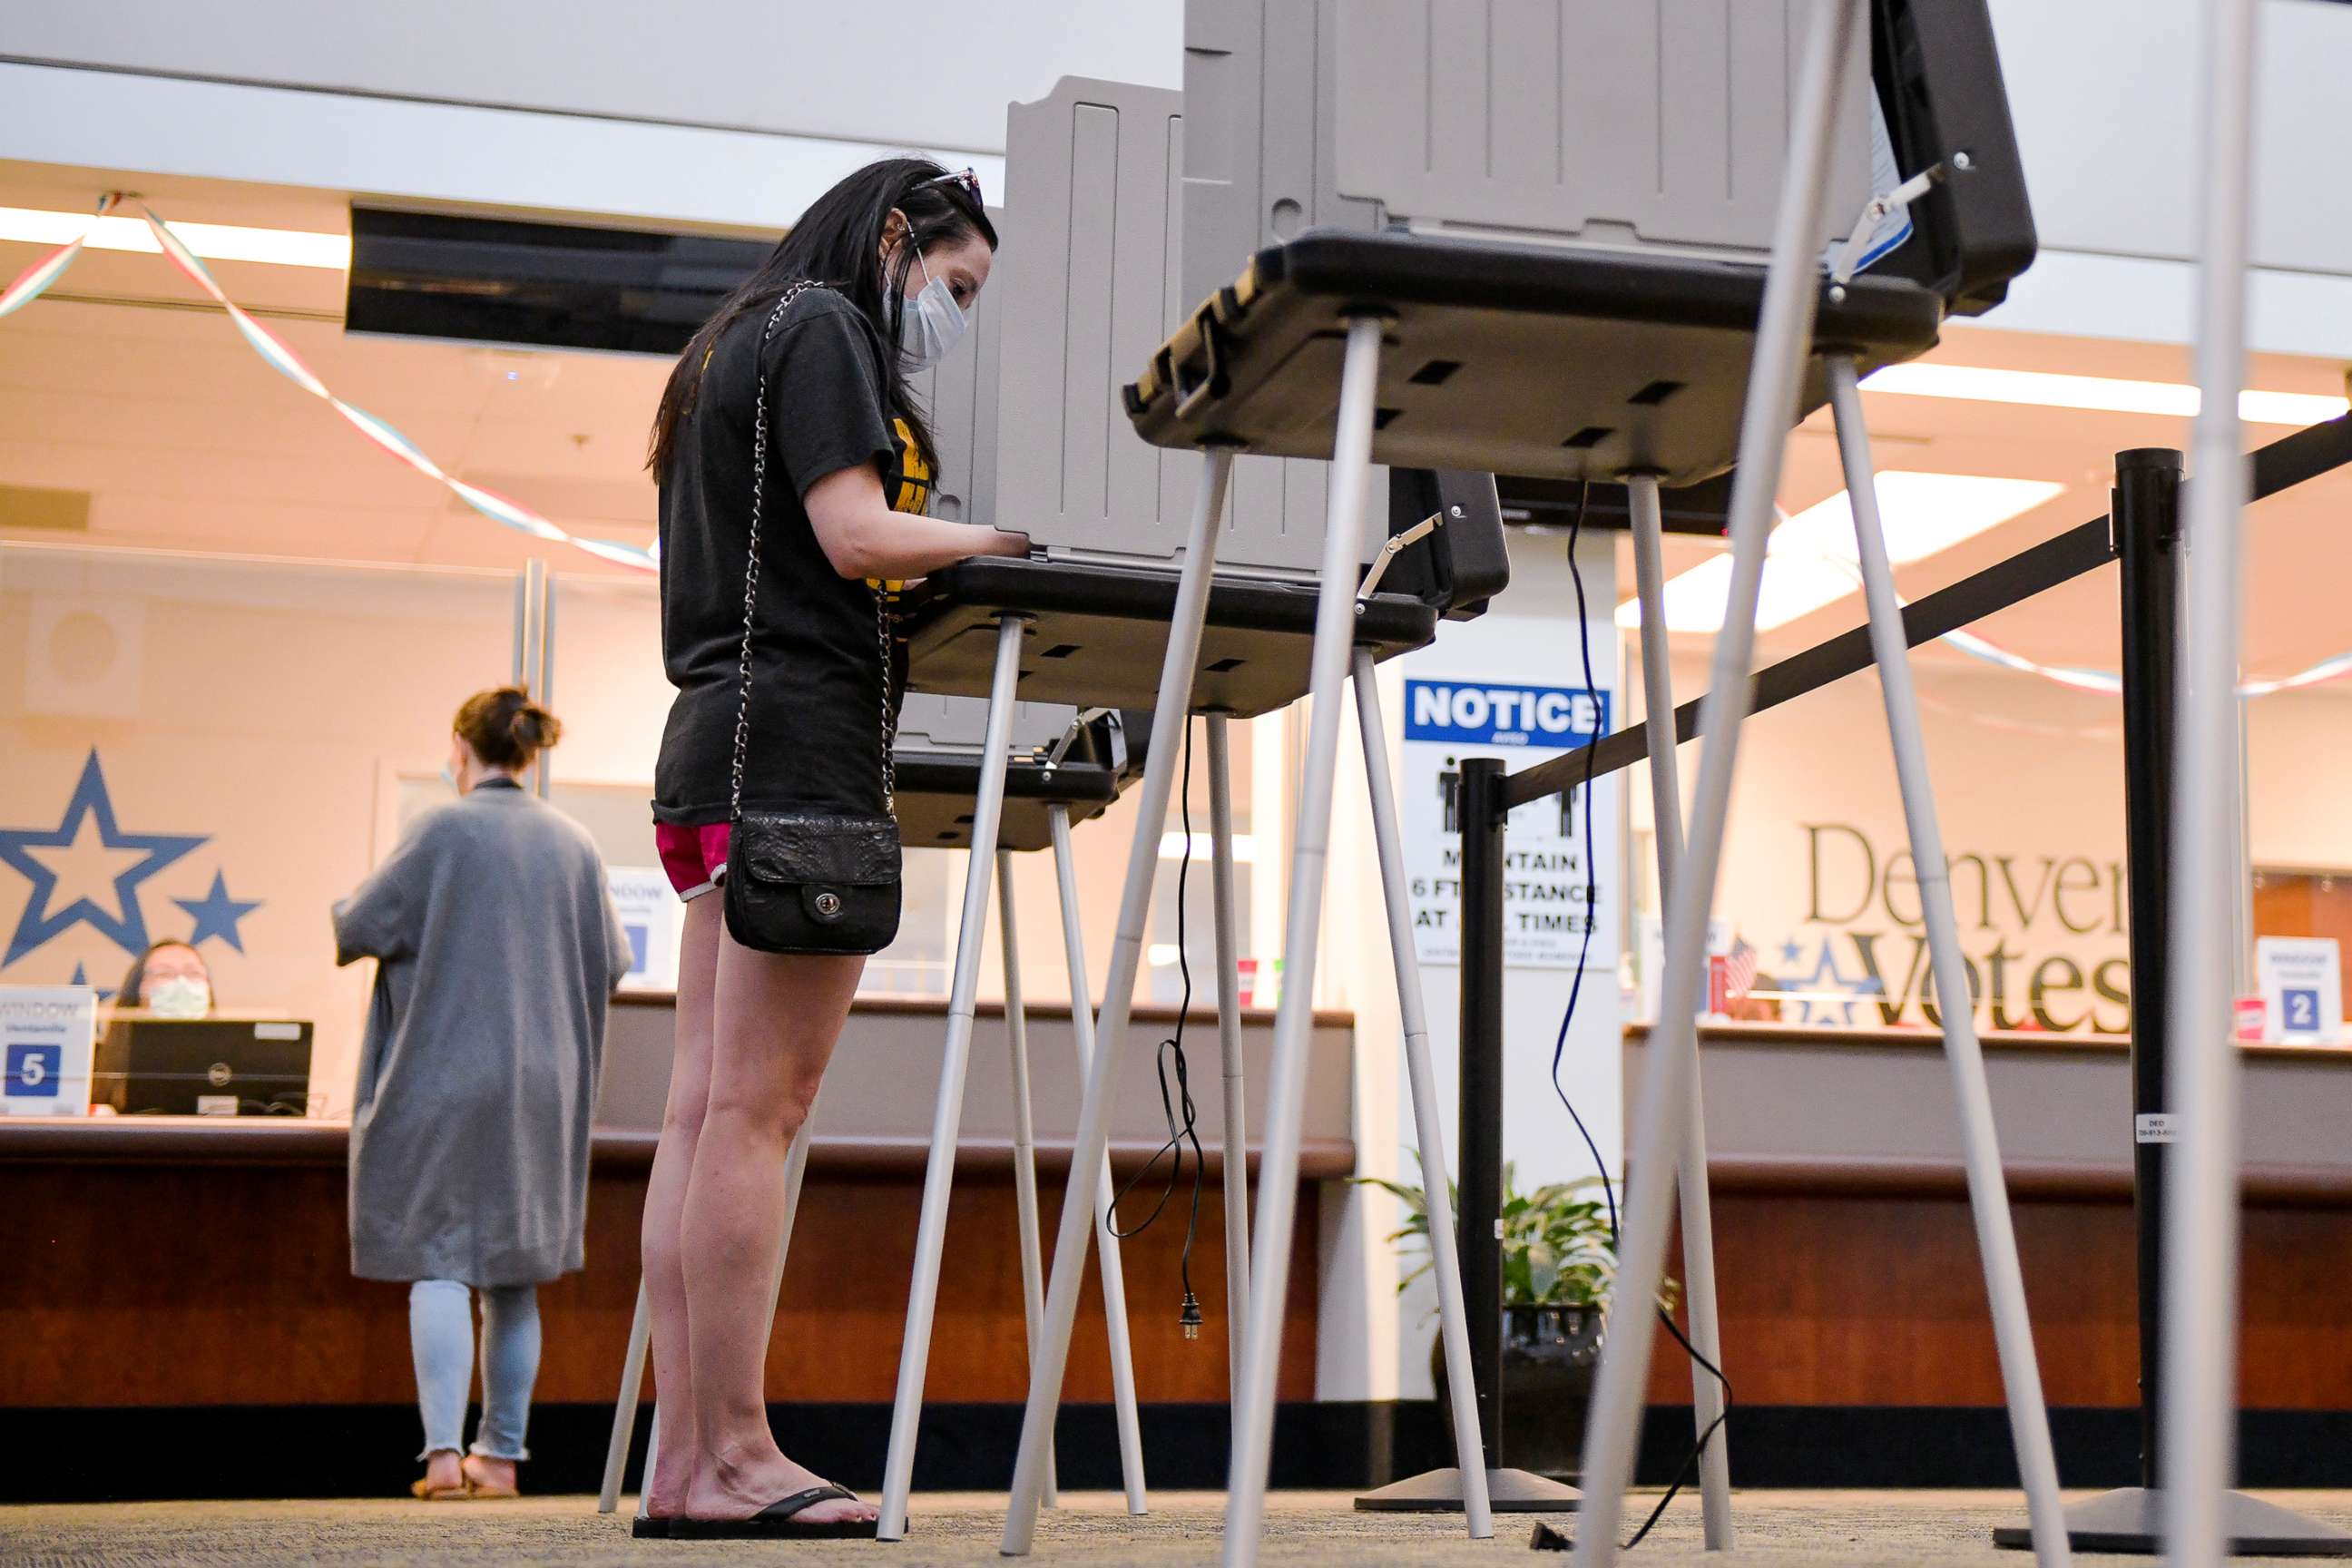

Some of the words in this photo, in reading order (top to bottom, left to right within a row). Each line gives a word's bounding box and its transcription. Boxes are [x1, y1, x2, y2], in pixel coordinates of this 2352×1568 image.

[1414, 685, 1604, 736] NOTICE
[1412, 879, 1426, 897] 6
[1416, 910, 1447, 929] AT
[1517, 913, 1597, 934] TIMES
[2291, 994, 2311, 1025] 2
[21, 1053, 45, 1086] 5
